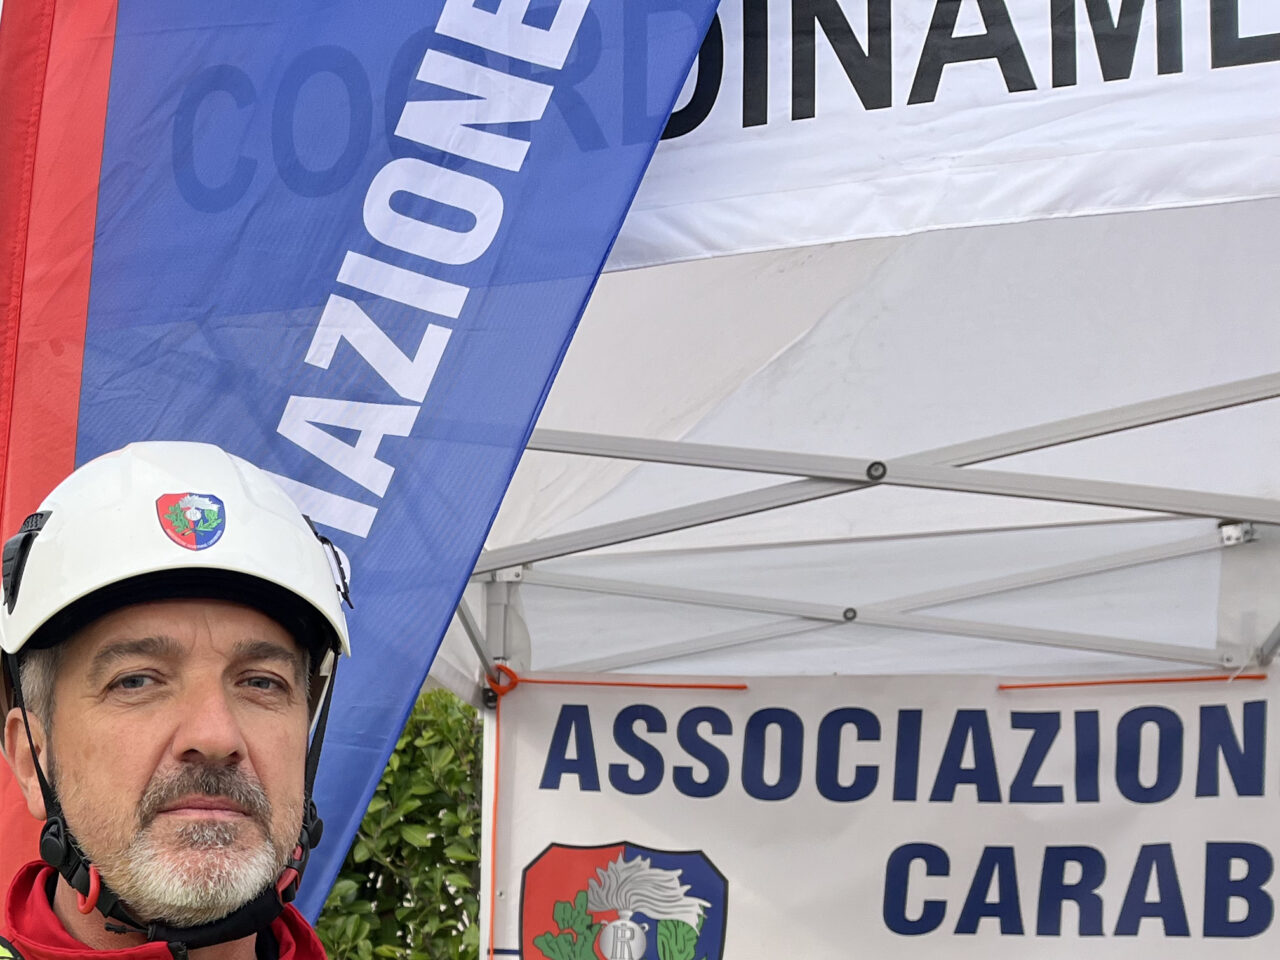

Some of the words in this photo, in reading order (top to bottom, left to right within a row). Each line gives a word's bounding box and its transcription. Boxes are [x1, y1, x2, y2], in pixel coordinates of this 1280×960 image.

[261, 0, 591, 590] IAZIONE
[538, 699, 1268, 806] ASSOCIAZION
[881, 841, 1275, 939] CARAB
